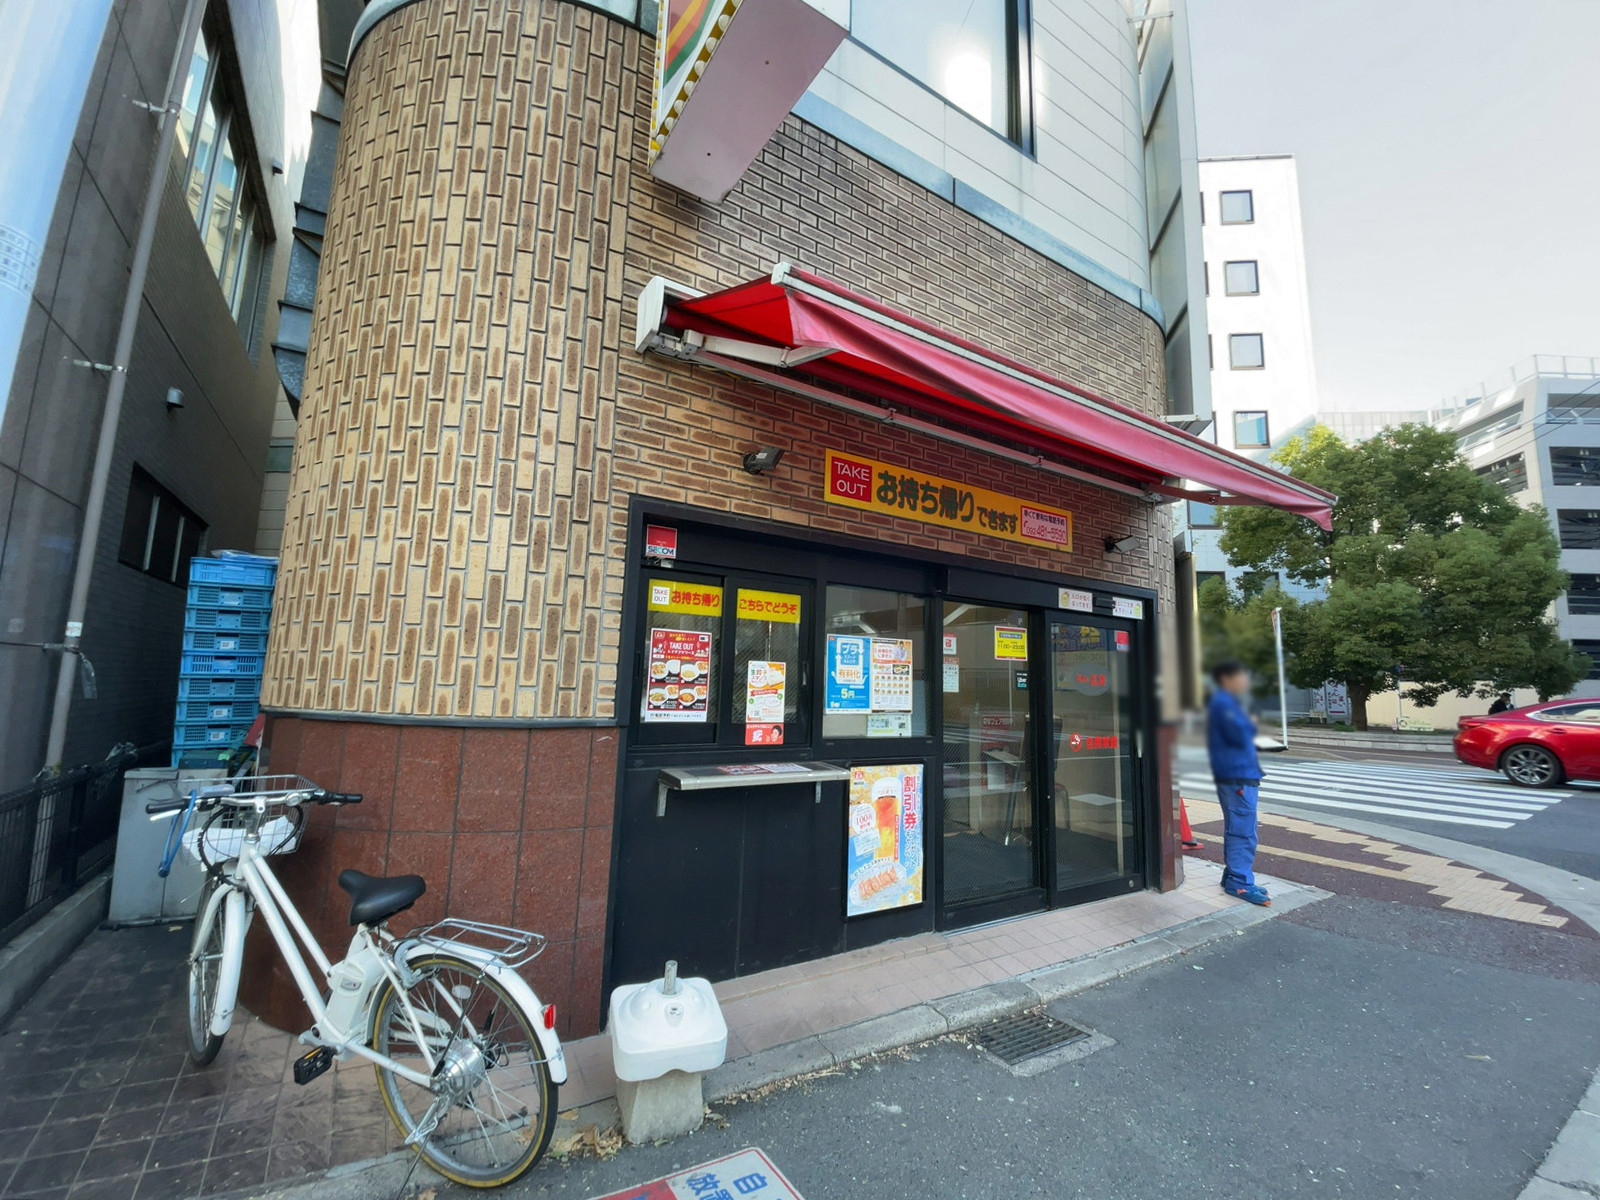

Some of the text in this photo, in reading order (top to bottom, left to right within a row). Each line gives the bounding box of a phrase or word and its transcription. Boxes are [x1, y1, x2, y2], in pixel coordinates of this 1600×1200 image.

[834, 461, 870, 482] TAKE
[836, 479, 867, 497] OUT
[648, 545, 674, 555] SECOM
[671, 590, 720, 607] お持ち帰り
[739, 599, 798, 615] こちらでどうぞ
[669, 642, 682, 650] TAKE
[903, 775, 918, 830] 割引券
